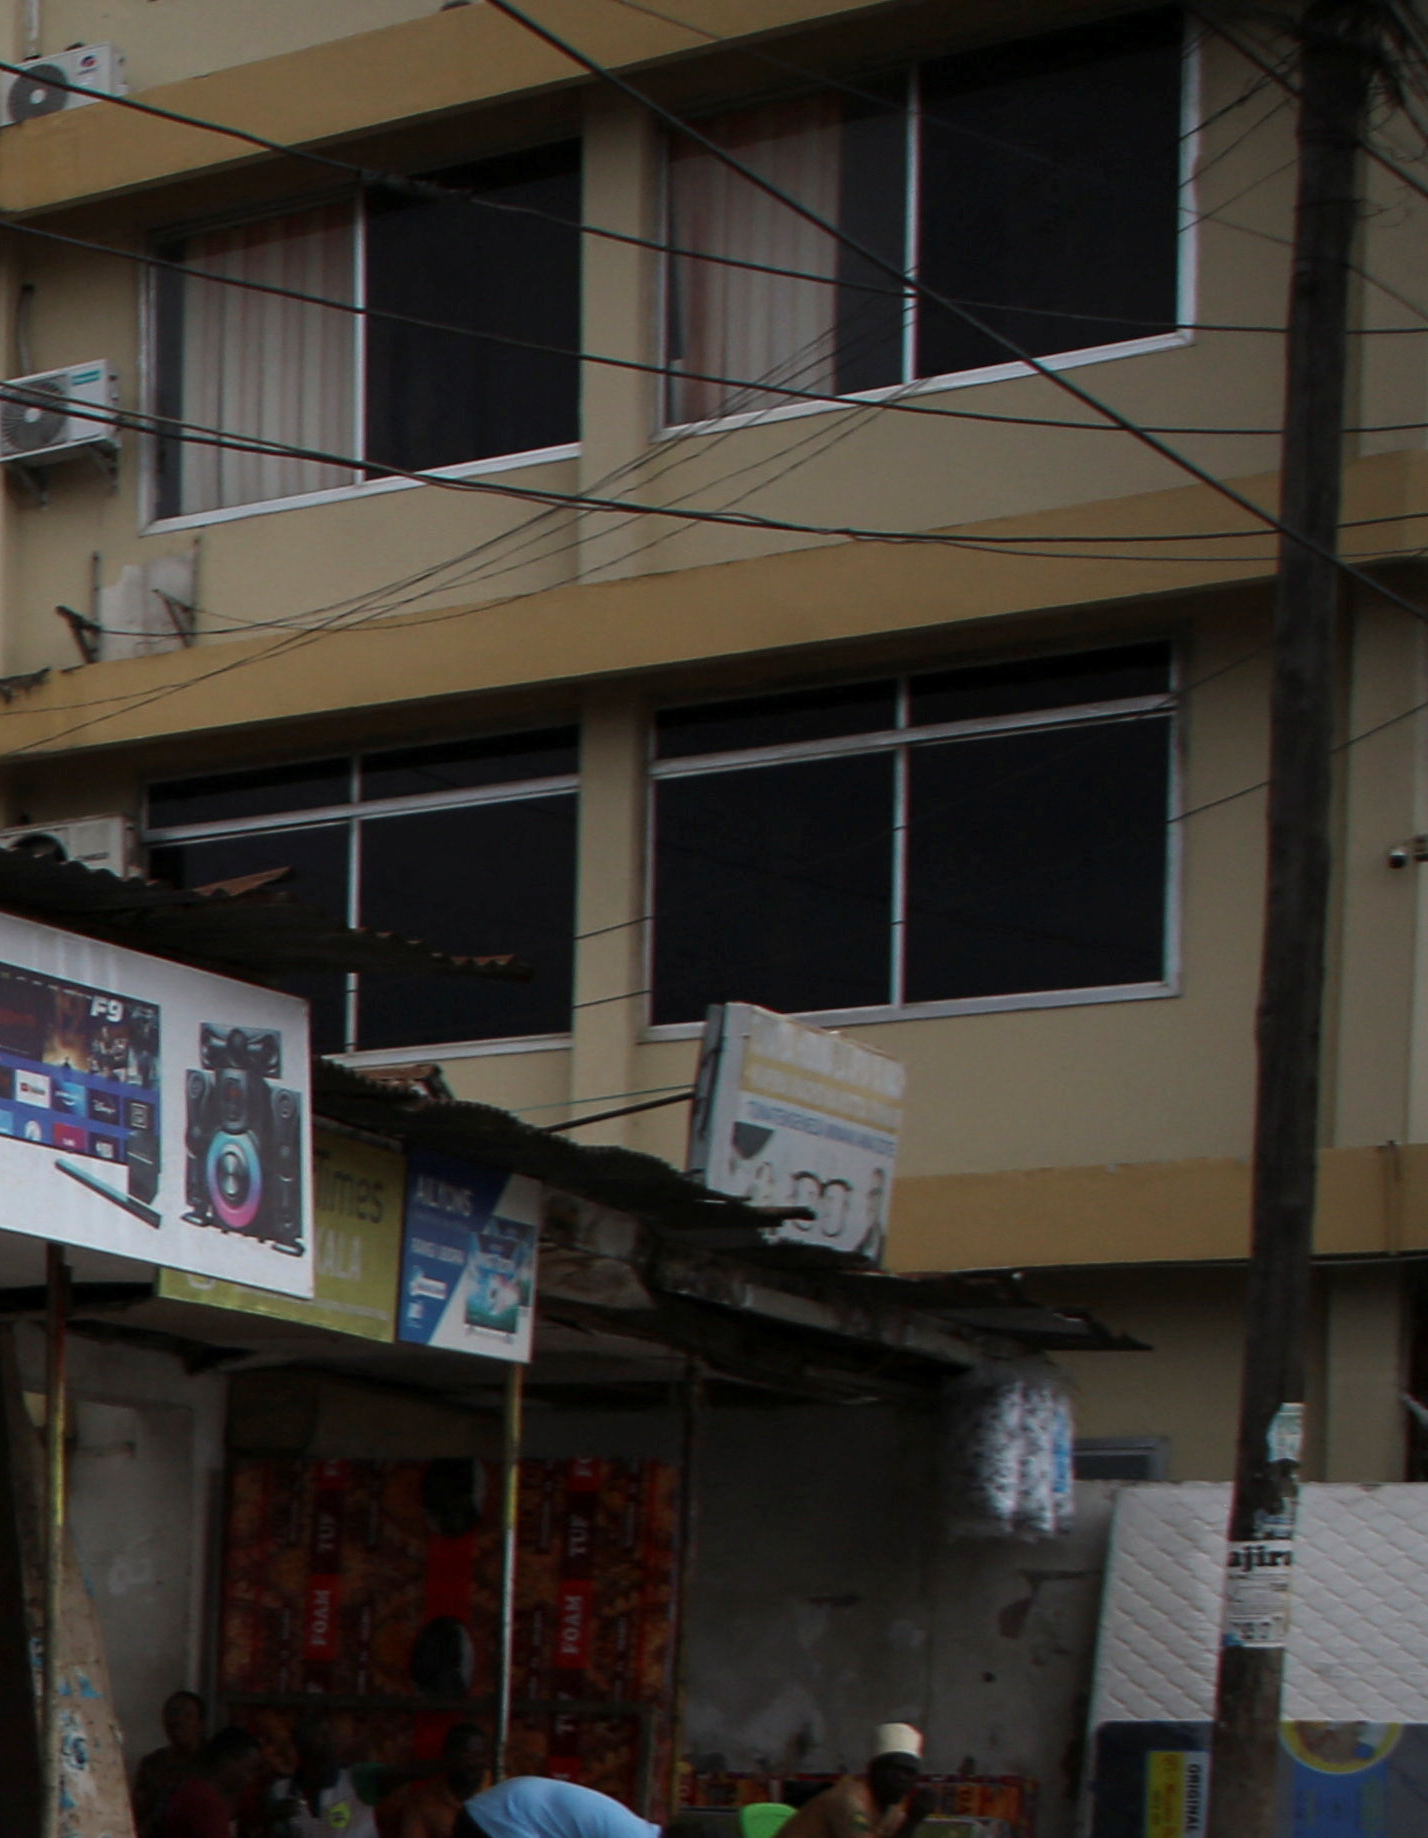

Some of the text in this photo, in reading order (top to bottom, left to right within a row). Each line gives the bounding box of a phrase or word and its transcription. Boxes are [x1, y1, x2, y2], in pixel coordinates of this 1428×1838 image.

[90, 996, 125, 1023] F9
[311, 1587, 332, 1648] FOAM
[562, 1593, 584, 1656] FOAM
[1184, 1762, 1202, 1834] ORIGINAL
